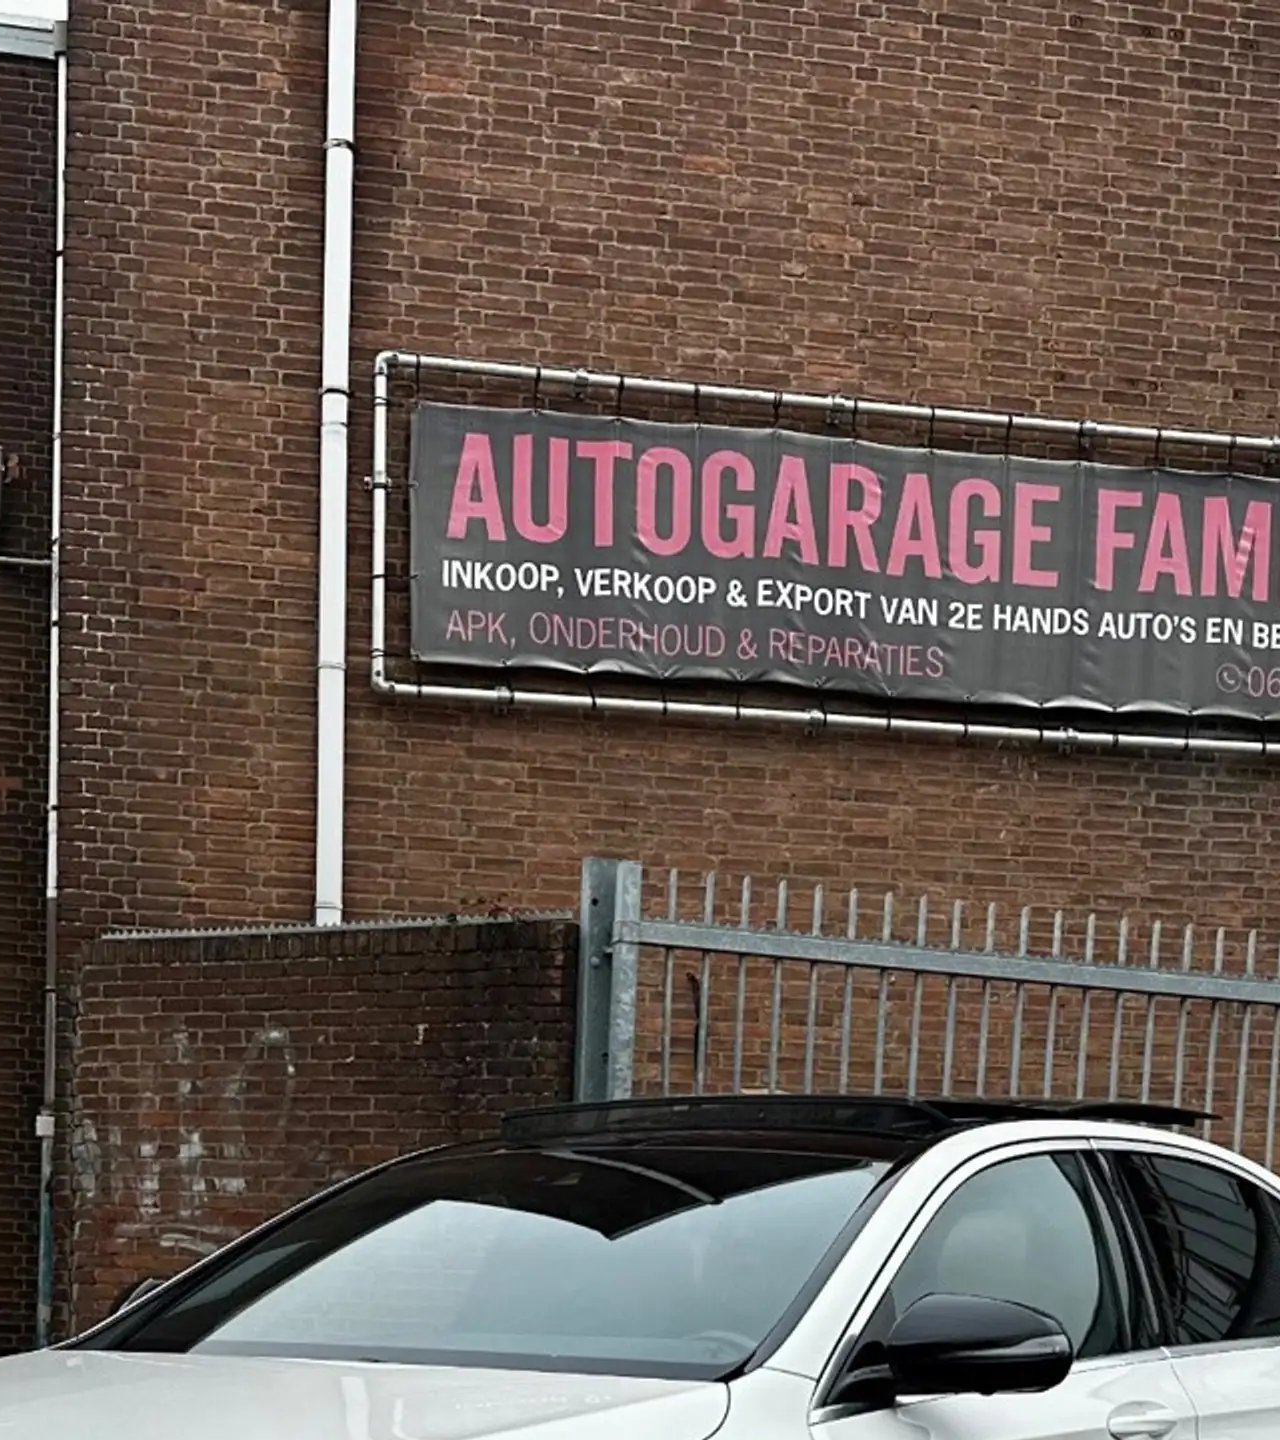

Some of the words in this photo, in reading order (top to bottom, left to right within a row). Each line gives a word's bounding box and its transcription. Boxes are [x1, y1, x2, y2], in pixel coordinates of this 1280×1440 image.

[446, 433, 1061, 588] AUTOGARAGE
[441, 559, 564, 598] INKOOP,
[573, 567, 717, 604] VERKOOP
[726, 579, 748, 607] &
[757, 579, 871, 619] EXPORT
[880, 595, 938, 626] VAN
[947, 602, 983, 630] 2E
[993, 604, 1090, 635] HANDS
[1098, 612, 1197, 644] AUTO'S
[1205, 618, 1244, 647] EN
[445, 609, 516, 649] APK,
[529, 611, 726, 658] ONDERHOUD
[736, 628, 757, 660] &
[769, 628, 945, 678] REPARATIES
